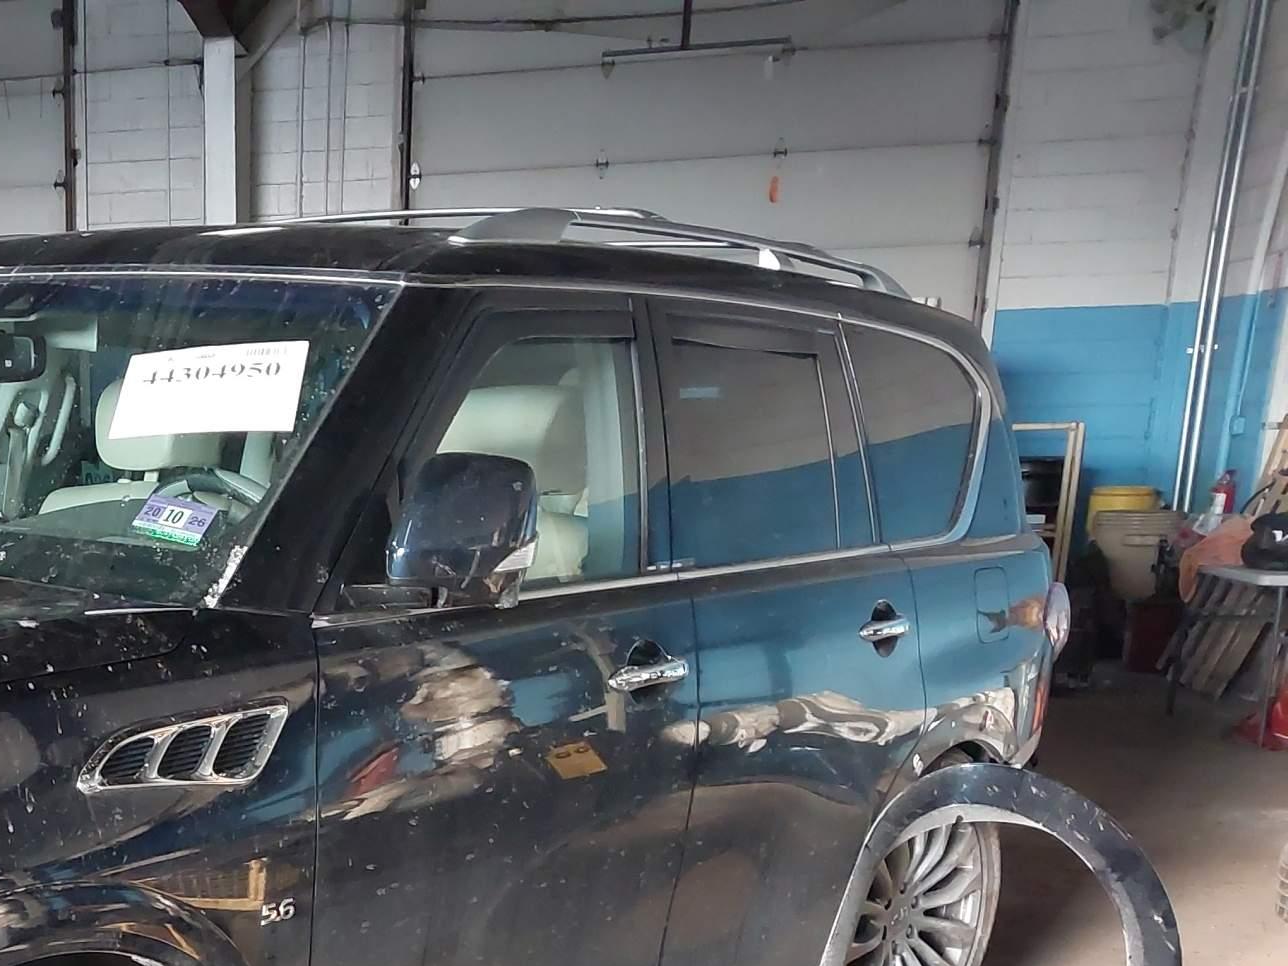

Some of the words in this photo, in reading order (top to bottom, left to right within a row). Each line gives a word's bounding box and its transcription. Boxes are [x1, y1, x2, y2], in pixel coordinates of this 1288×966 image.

[142, 361, 282, 385] 44304950
[143, 506, 161, 518] 20
[162, 508, 185, 525] 10
[188, 516, 207, 528] 26
